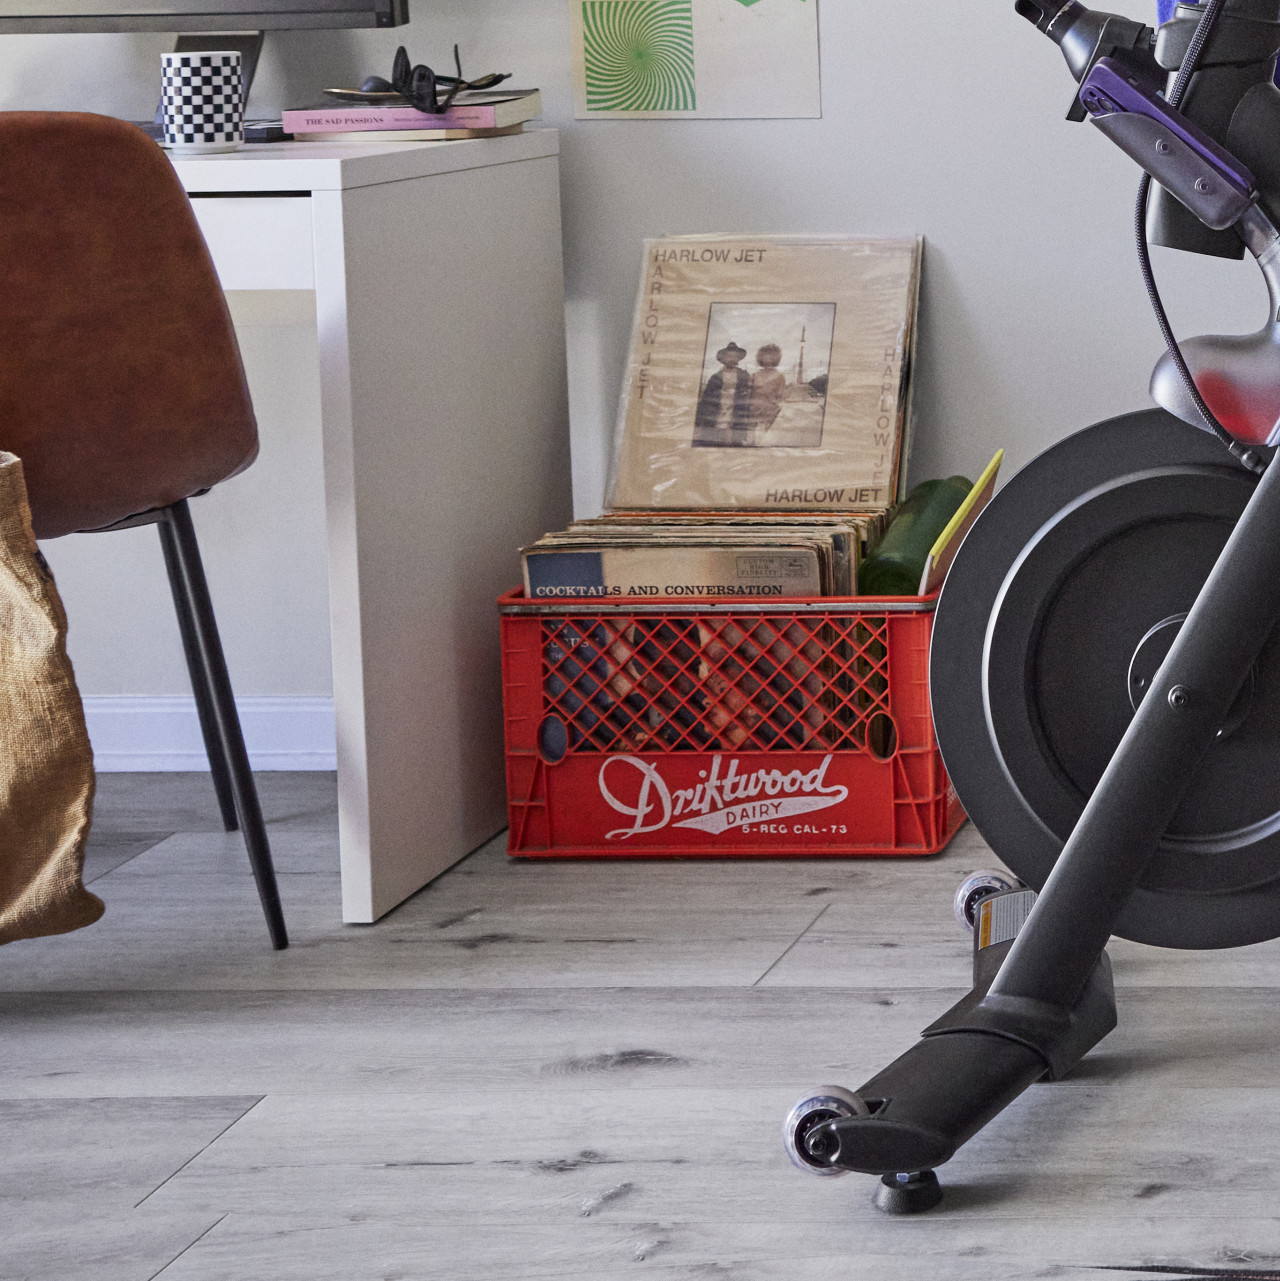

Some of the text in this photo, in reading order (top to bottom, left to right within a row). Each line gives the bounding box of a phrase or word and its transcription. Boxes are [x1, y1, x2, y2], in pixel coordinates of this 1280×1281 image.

[305, 117, 323, 125] THE
[325, 117, 342, 125] SAD
[344, 116, 384, 125] PASSIONS
[654, 249, 767, 263] HARLOW JET
[636, 351, 651, 399] JET
[765, 487, 883, 503] HARLOW JET
[536, 585, 783, 596] COCKTAILS AND CONVERSATION
[598, 754, 849, 840] Driftwood
[726, 801, 784, 826] DAIRY
